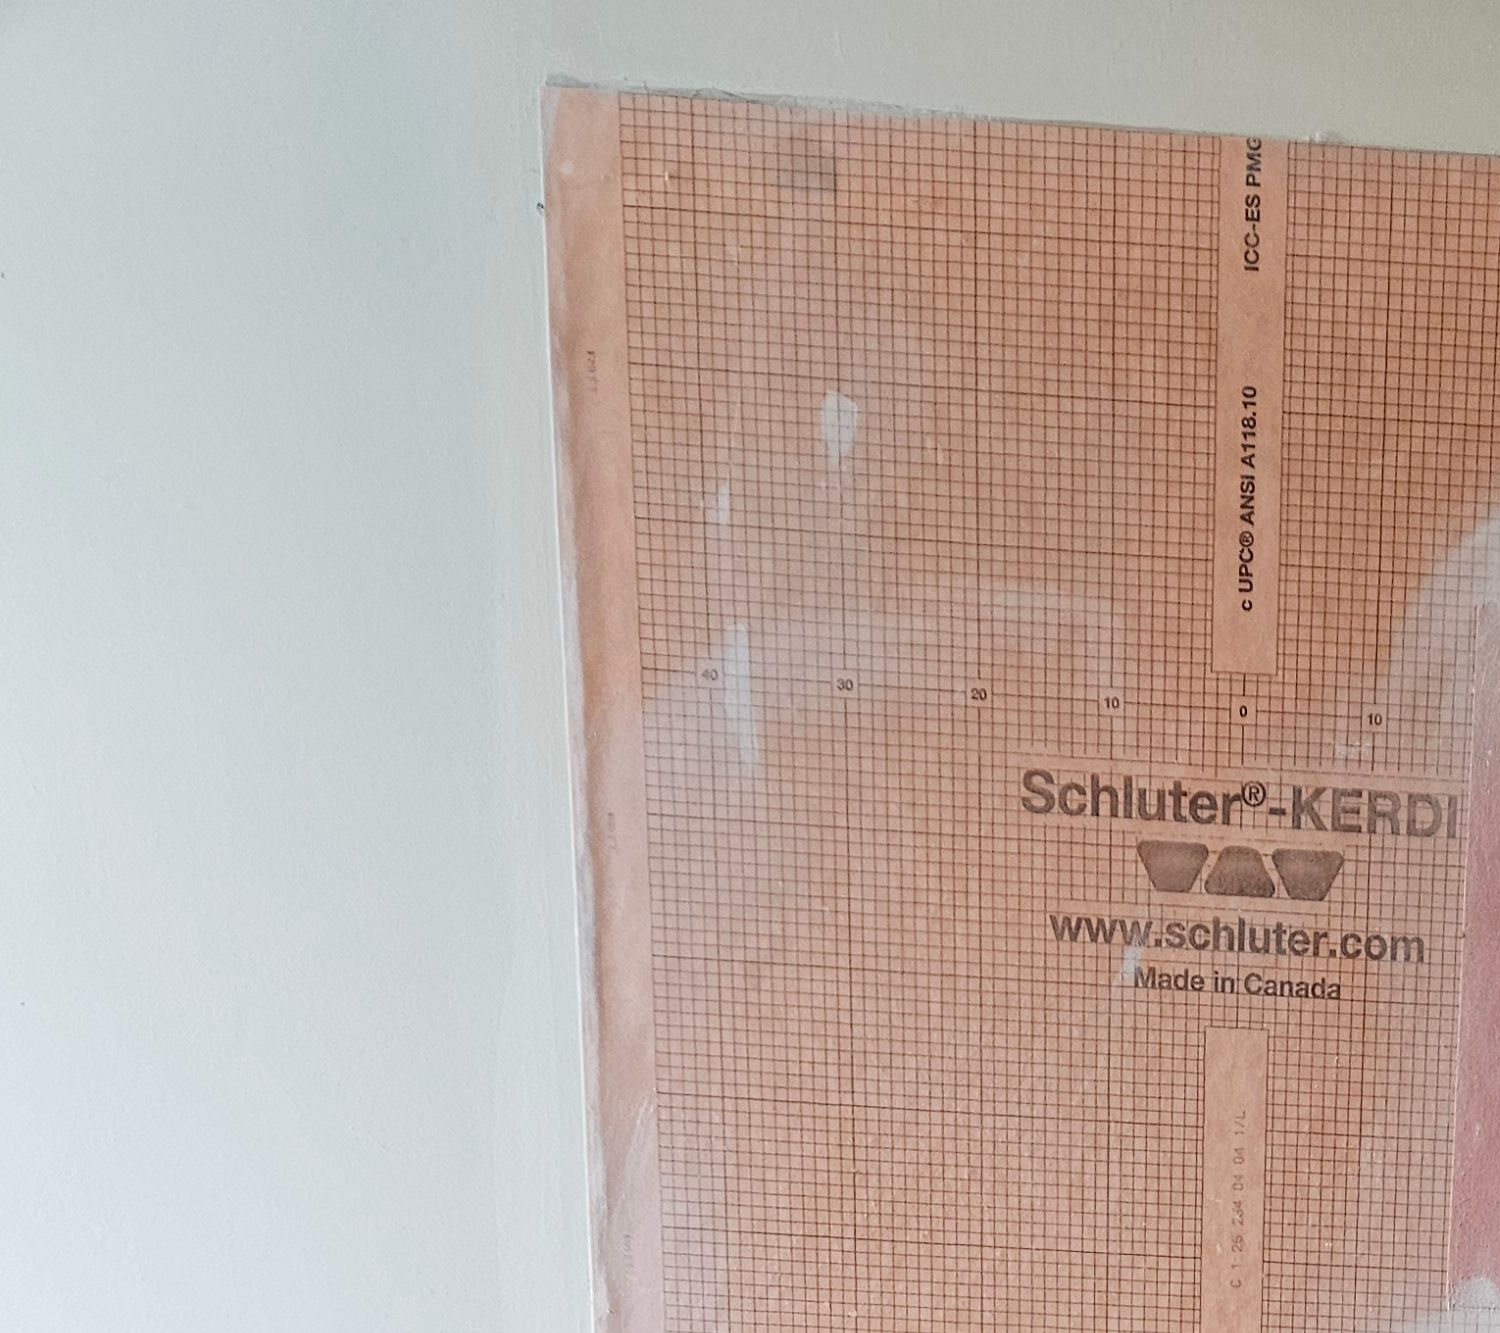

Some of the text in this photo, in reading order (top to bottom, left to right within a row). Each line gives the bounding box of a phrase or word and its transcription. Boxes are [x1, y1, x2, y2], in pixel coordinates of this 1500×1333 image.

[1244, 194, 1260, 272] ICC-ES
[1240, 385, 1257, 469] A118.10
[1240, 475, 1256, 525] ANSI
[837, 679, 854, 691] 30
[970, 688, 987, 701] 20
[1105, 697, 1120, 709] 10
[1239, 705, 1248, 718] 0
[1368, 713, 1382, 726] 10
[1049, 914, 1425, 964] www.schluter.com
[1133, 966, 1342, 1000] Made in Canada
